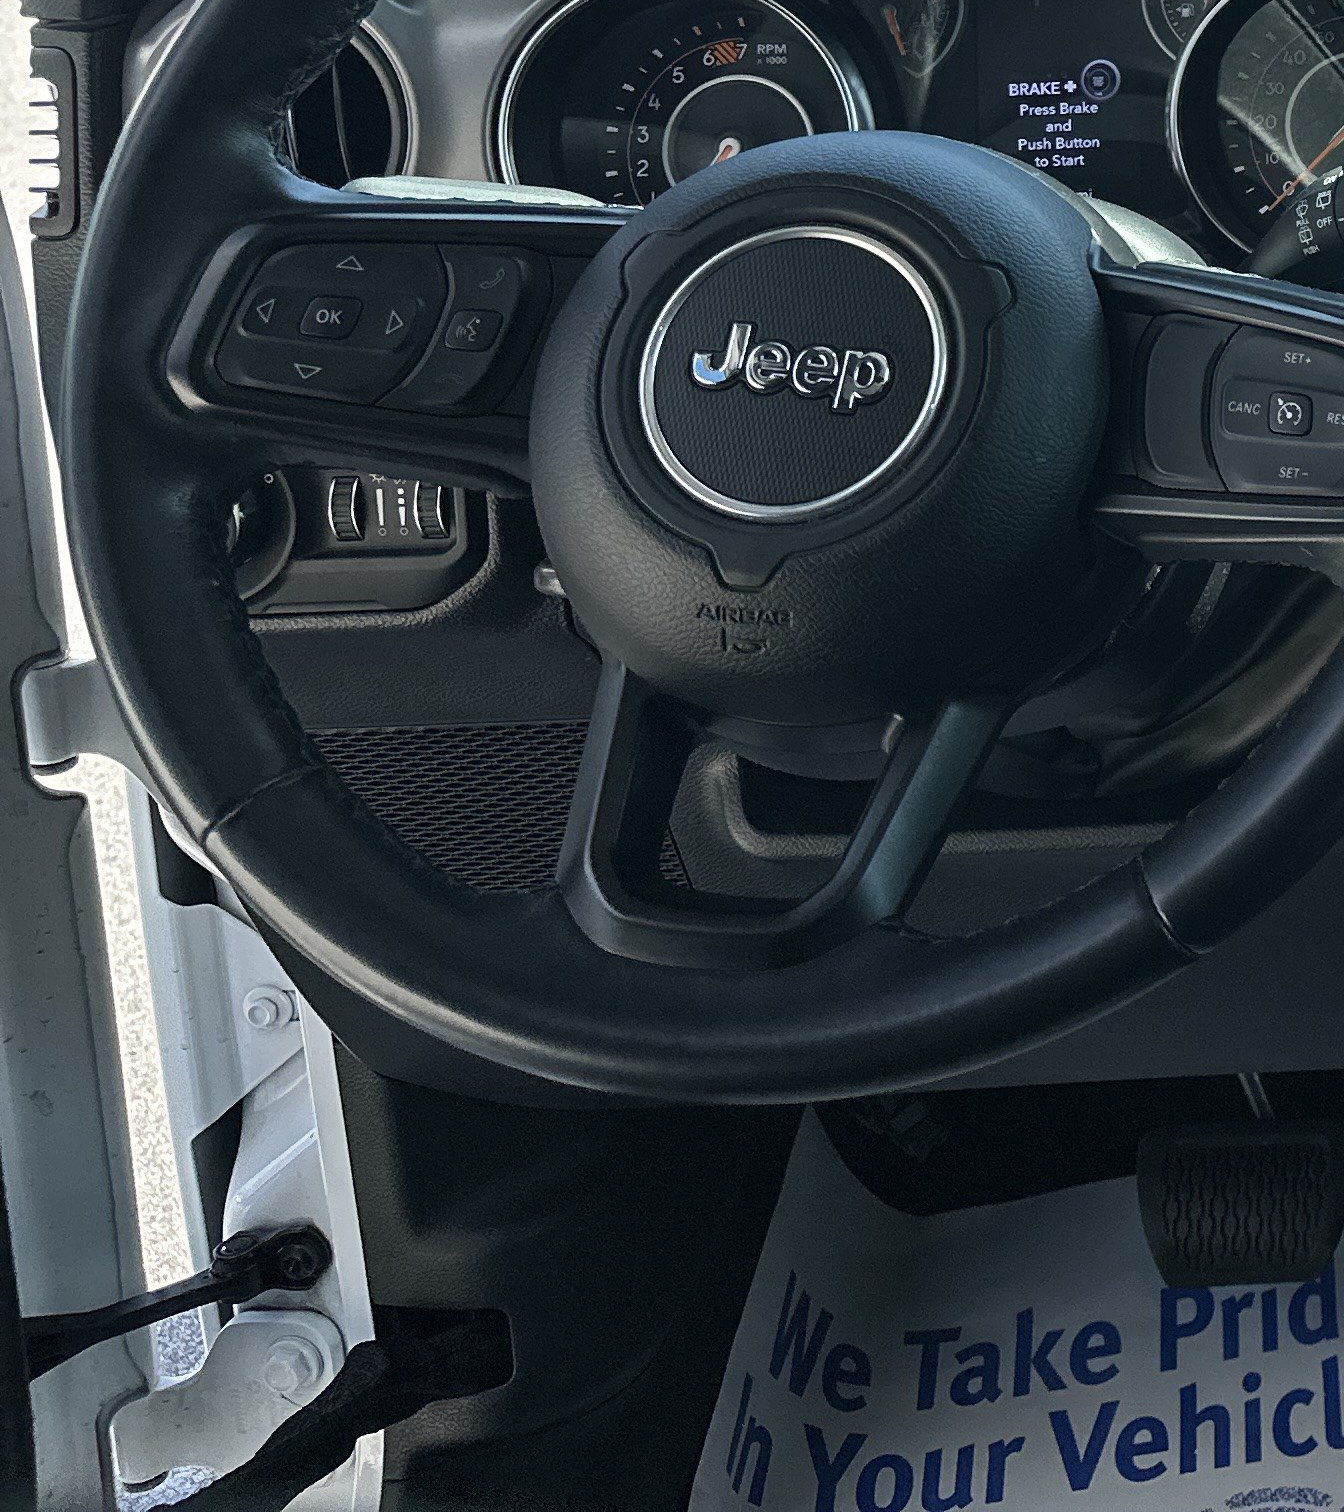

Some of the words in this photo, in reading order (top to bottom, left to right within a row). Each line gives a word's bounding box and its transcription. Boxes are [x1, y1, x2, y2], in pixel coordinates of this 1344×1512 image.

[702, 47, 715, 66] 6
[735, 43, 748, 61] 7
[757, 43, 788, 56] RPM
[766, 56, 788, 65] 1000
[1282, 50, 1307, 66] 40
[672, 67, 685, 84] 5
[1009, 82, 1061, 97] BRAKE
[1265, 81, 1286, 95] 30
[647, 93, 661, 111] 4
[1019, 103, 1056, 116] Press
[1059, 102, 1099, 115] Brake
[1045, 119, 1072, 133] and
[1254, 114, 1277, 130] 20
[636, 126, 650, 144] 3
[1018, 137, 1052, 151] Push
[1055, 136, 1100, 150] Button
[1034, 157, 1049, 168] to
[1052, 154, 1085, 167] Start
[1265, 152, 1280, 164] 10
[636, 160, 649, 178] 2
[1316, 217, 1333, 229] OFF
[1302, 245, 1321, 256] PUSH
[315, 307, 342, 325] OK
[693, 322, 892, 412] Jeep
[1227, 400, 1262, 416] CANC
[767, 1268, 873, 1412] We
[904, 1309, 1123, 1412] Take
[726, 1372, 774, 1507] In
[803, 1422, 1027, 1512] Your
